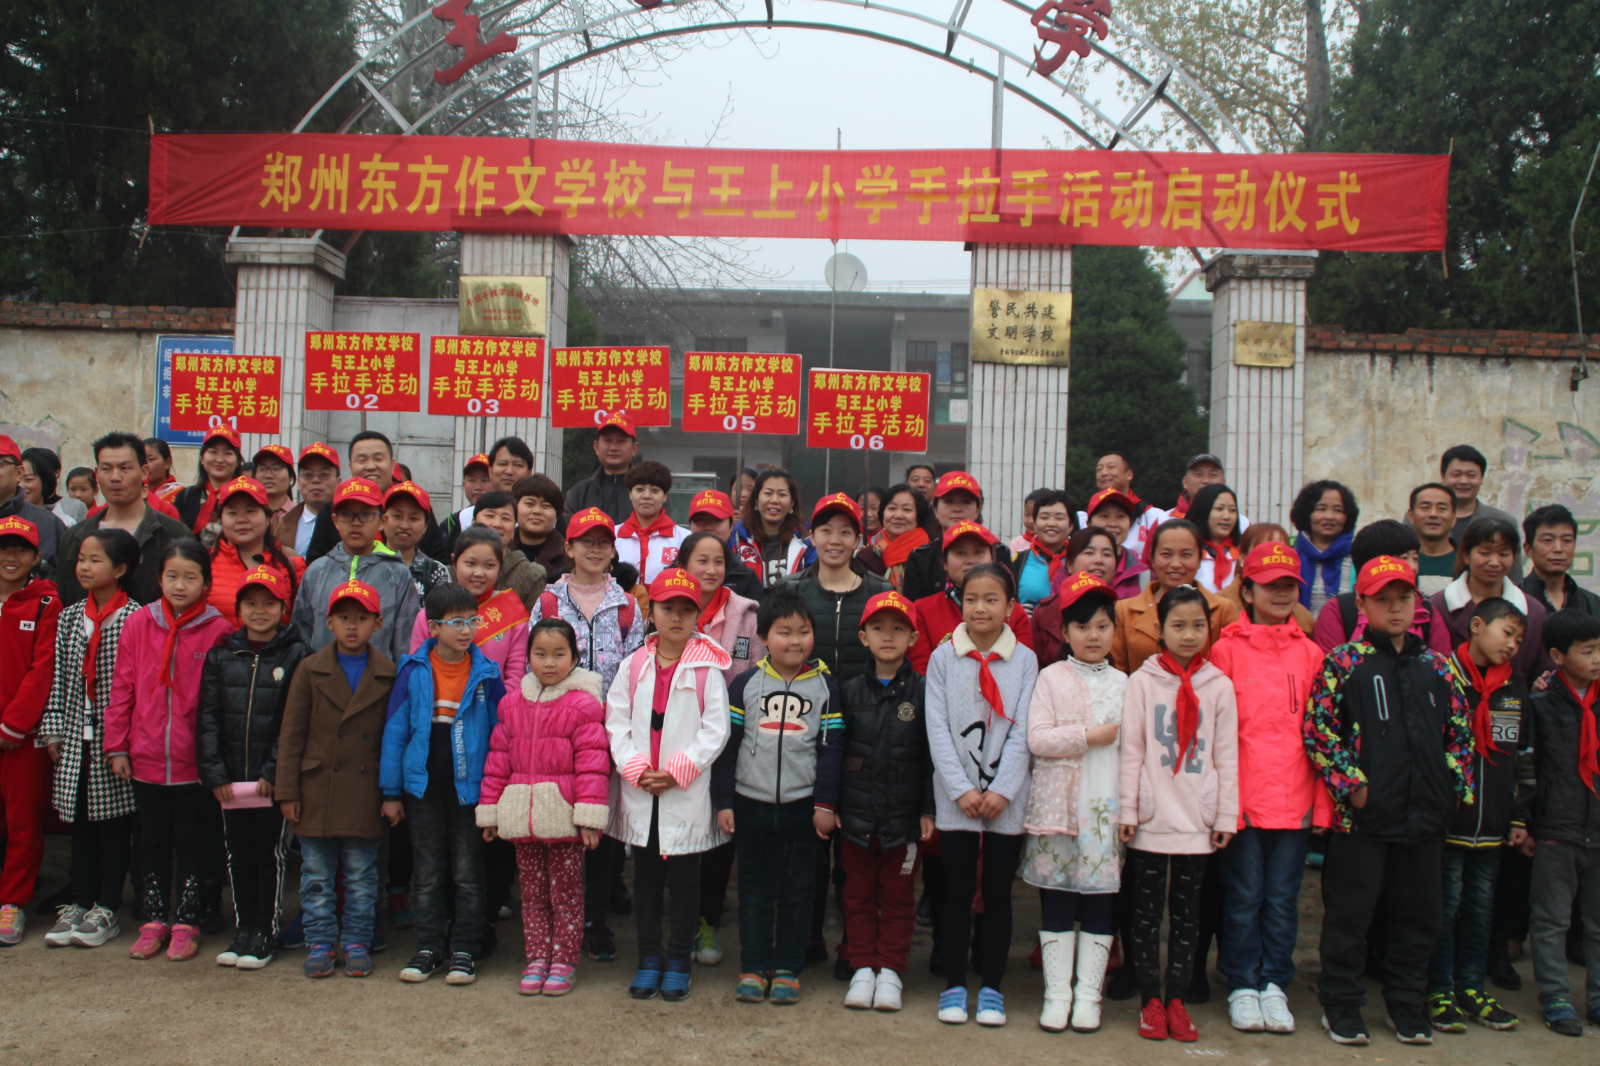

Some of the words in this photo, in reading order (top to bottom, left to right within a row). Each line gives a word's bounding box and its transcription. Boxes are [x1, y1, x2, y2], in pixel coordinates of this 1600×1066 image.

[259, 151, 1361, 235] 郑州东方作文学校与王上小学手拉手活动启动仪式
[987, 299, 1057, 319] 警民共建
[987, 322, 1055, 342] 文明学校
[310, 334, 413, 351] 郑州东方作文学校
[434, 338, 537, 357] 郑州东方作文学校
[176, 356, 275, 374] 郑州东方作文学校
[331, 354, 395, 371] 与王上小学
[556, 349, 662, 367] 郑州东方作文学校
[689, 355, 793, 373] 郑州东方作文学校
[454, 358, 518, 376] 与王上小学
[195, 376, 257, 393] 与王上小学
[310, 372, 417, 395] 手拉手活动
[578, 369, 644, 386] 与王上小学
[709, 375, 774, 393] 与王上小学
[814, 373, 921, 392] 郑州东方作文学校
[433, 376, 540, 401] 手拉手活动
[175, 393, 278, 418] 手拉手活动
[346, 393, 379, 409] 02
[467, 398, 500, 414] 03
[556, 387, 667, 410] 手拉手活动
[687, 393, 796, 417] 手拉手活动
[835, 393, 902, 412] 与王上小学
[208, 415, 238, 430] 01
[594, 409, 626, 424] 0
[723, 415, 756, 431] 05
[813, 412, 924, 437] 手拉手活动
[850, 434, 884, 450] 06
[580, 515, 609, 525] 东方作文
[1263, 555, 1295, 566] 东方作文
[246, 572, 277, 584] 东方作文
[1370, 563, 1404, 576] 东方作文
[338, 586, 370, 597] 东方作文
[665, 577, 695, 591] 东方作文
[876, 599, 908, 613] 东方作文
